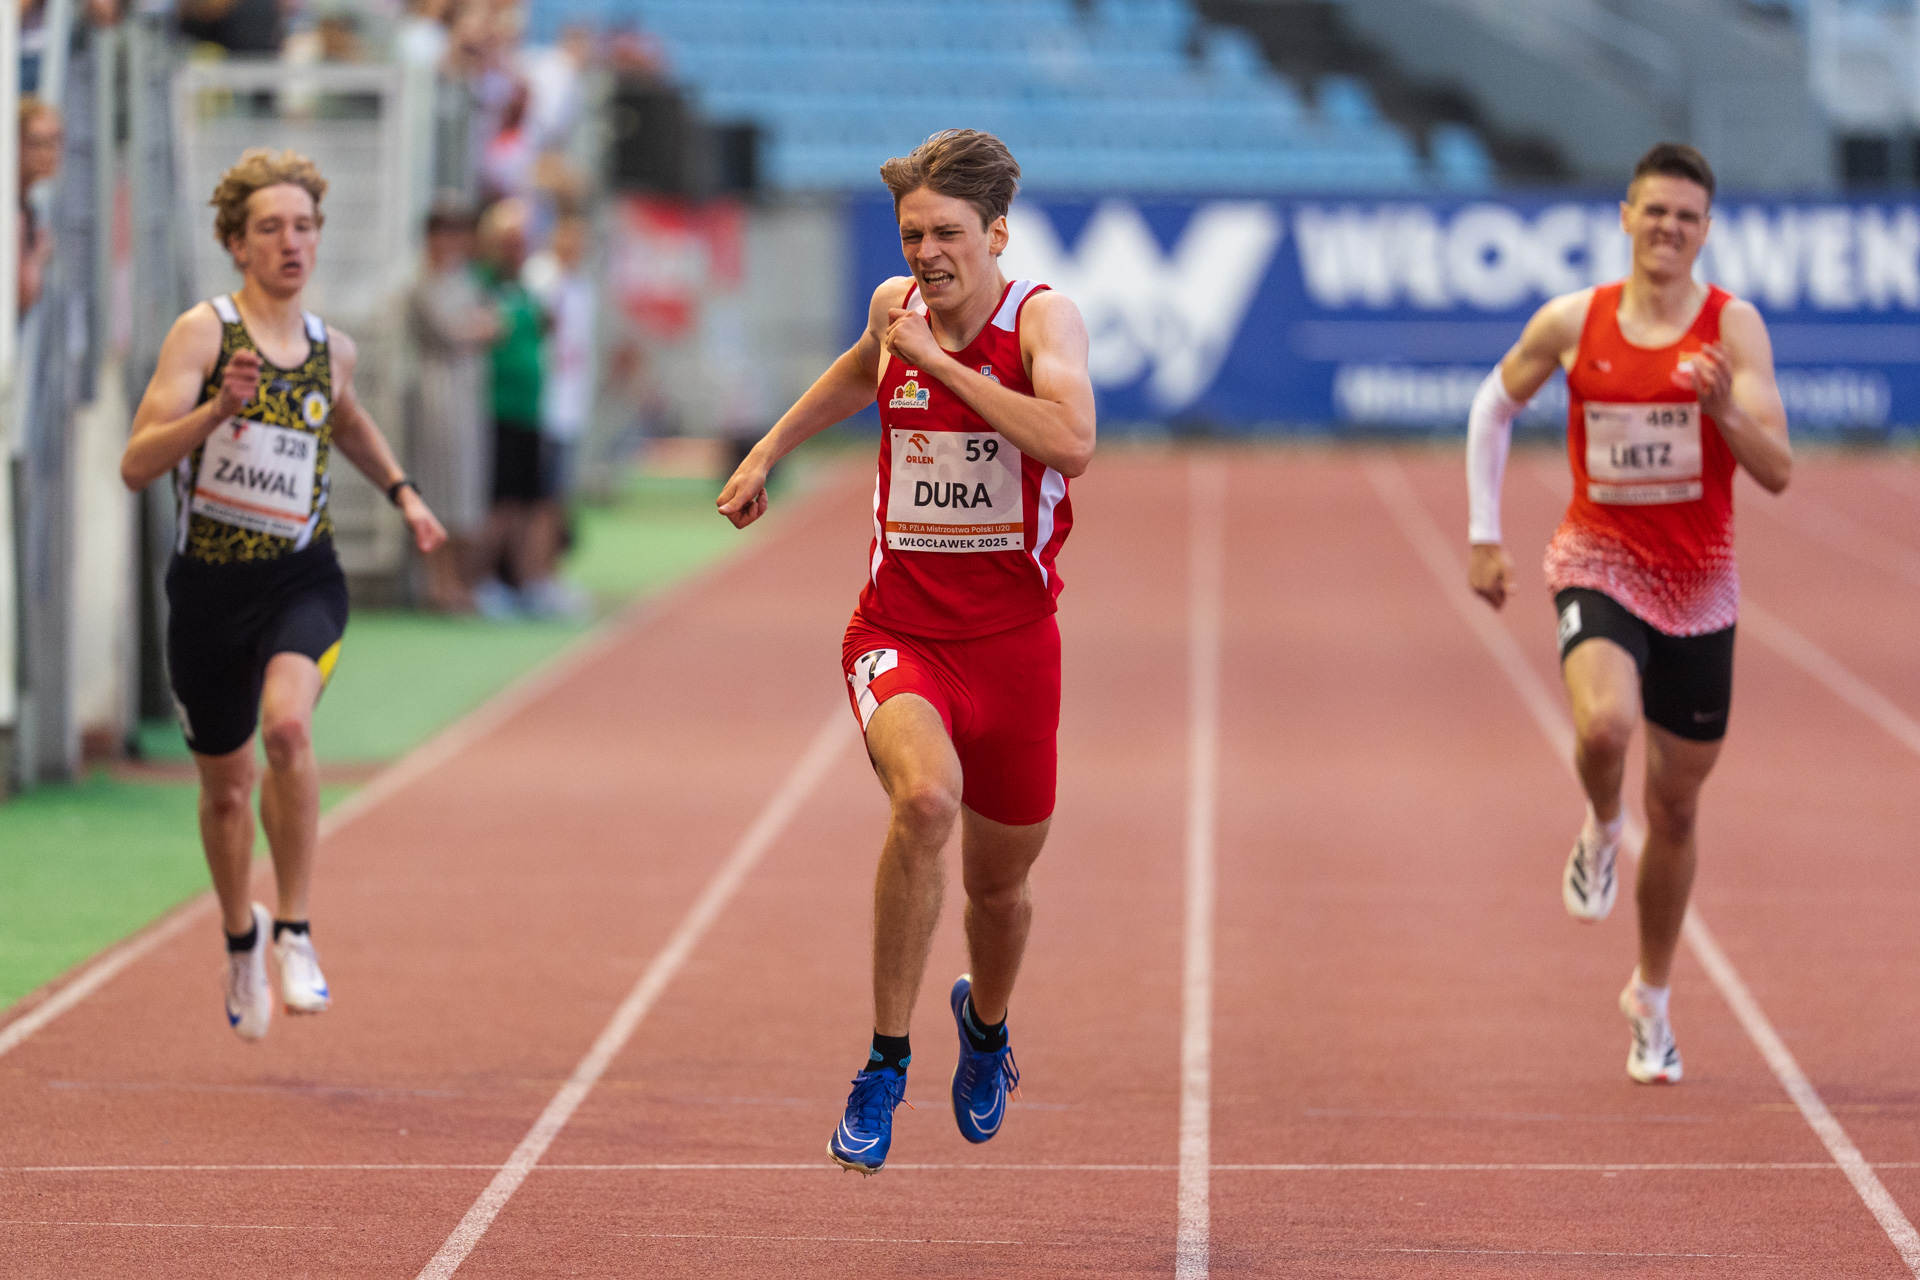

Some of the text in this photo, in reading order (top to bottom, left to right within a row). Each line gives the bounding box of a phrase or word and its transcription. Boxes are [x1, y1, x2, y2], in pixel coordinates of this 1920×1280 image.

[905, 369, 918, 377] BKS
[965, 439, 999, 462] 59
[1610, 442, 1672, 468] LIETZ
[906, 455, 934, 464] ORLEN
[914, 480, 993, 508] DURA
[898, 523, 1010, 533] 79. PZLA Mistrzostwa Polski U20
[899, 537, 1008, 549] WŁOCŁAWEK 2025
[861, 650, 886, 682] 7
